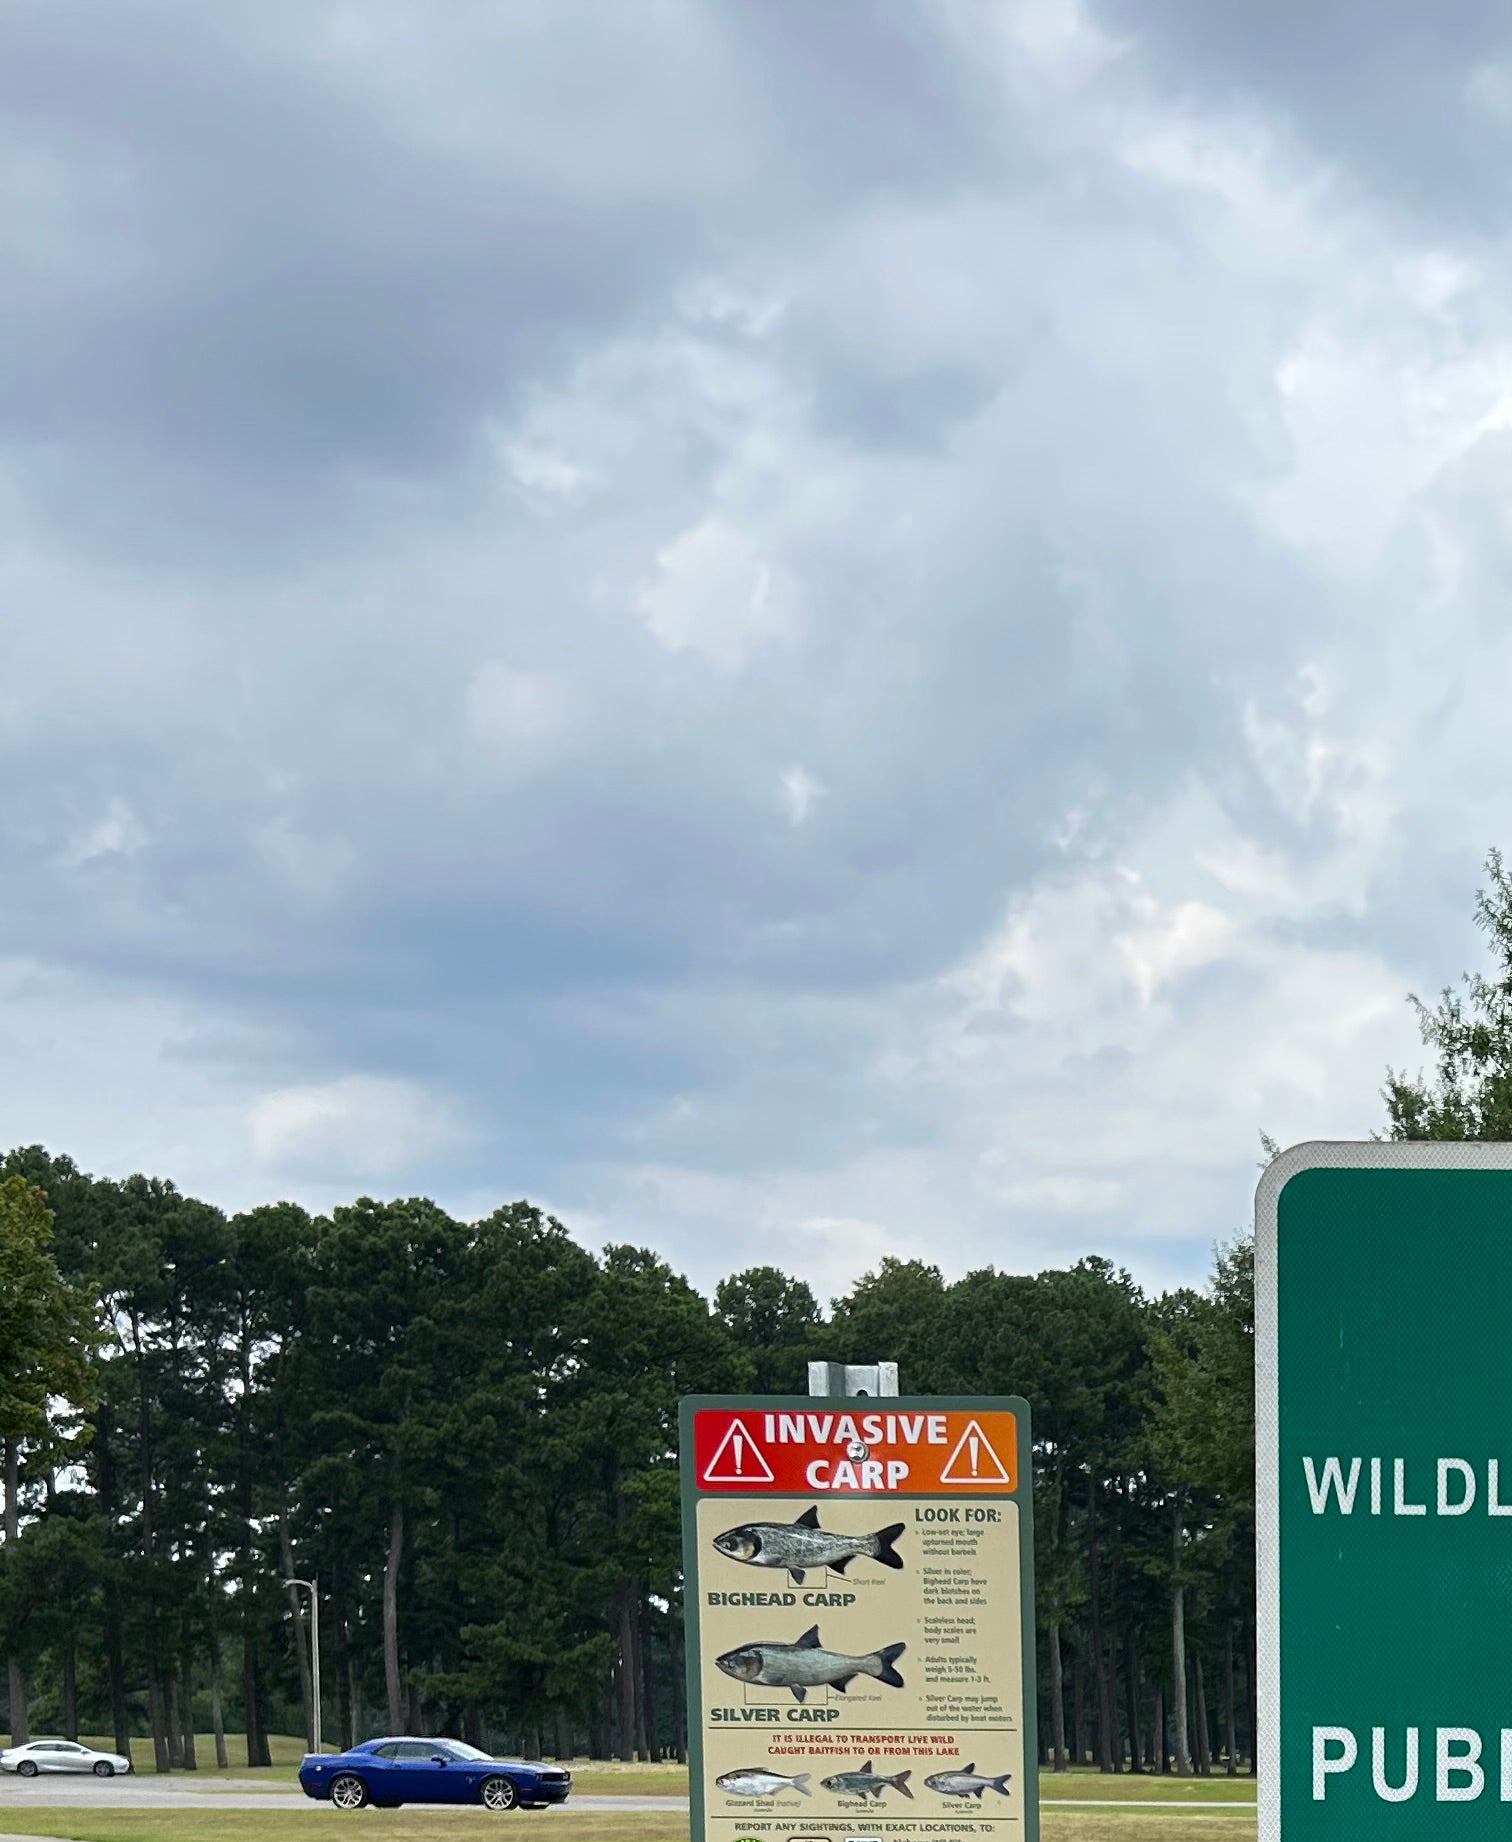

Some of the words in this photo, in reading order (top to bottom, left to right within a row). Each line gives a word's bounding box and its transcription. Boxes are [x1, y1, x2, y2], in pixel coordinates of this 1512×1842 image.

[765, 1414, 947, 1445] INVASIVE
[806, 1460, 909, 1489] CARP
[915, 1508, 960, 1522] LOOK
[965, 1508, 1001, 1522] FOR:
[707, 1592, 796, 1606] BIGHEAD
[803, 1593, 856, 1607] CARP
[711, 1708, 780, 1722] SILVER
[787, 1709, 840, 1722] CARP
[772, 1734, 781, 1742] IT
[784, 1735, 793, 1743] IS
[796, 1735, 834, 1743] ILLEGAL
[836, 1735, 848, 1743] TO
[850, 1735, 905, 1743] TRANSPORT
[908, 1736, 928, 1744] LIVE
[930, 1736, 954, 1744] WILD
[768, 1746, 806, 1755] CAUGHT
[808, 1746, 850, 1755] BAITFISH
[852, 1747, 865, 1755] TO
[868, 1747, 880, 1755] OR
[883, 1747, 910, 1755] FROM
[912, 1747, 933, 1755] THIS
[936, 1747, 960, 1756] LAKE
[735, 1823, 772, 1831] REPORT
[775, 1823, 796, 1831] ANY
[799, 1823, 855, 1832] SIGHTINGS,
[857, 1823, 883, 1831] WITH
[885, 1823, 917, 1832] EXACT
[919, 1824, 977, 1833] LOCATIONS,
[979, 1824, 995, 1832] TO:
